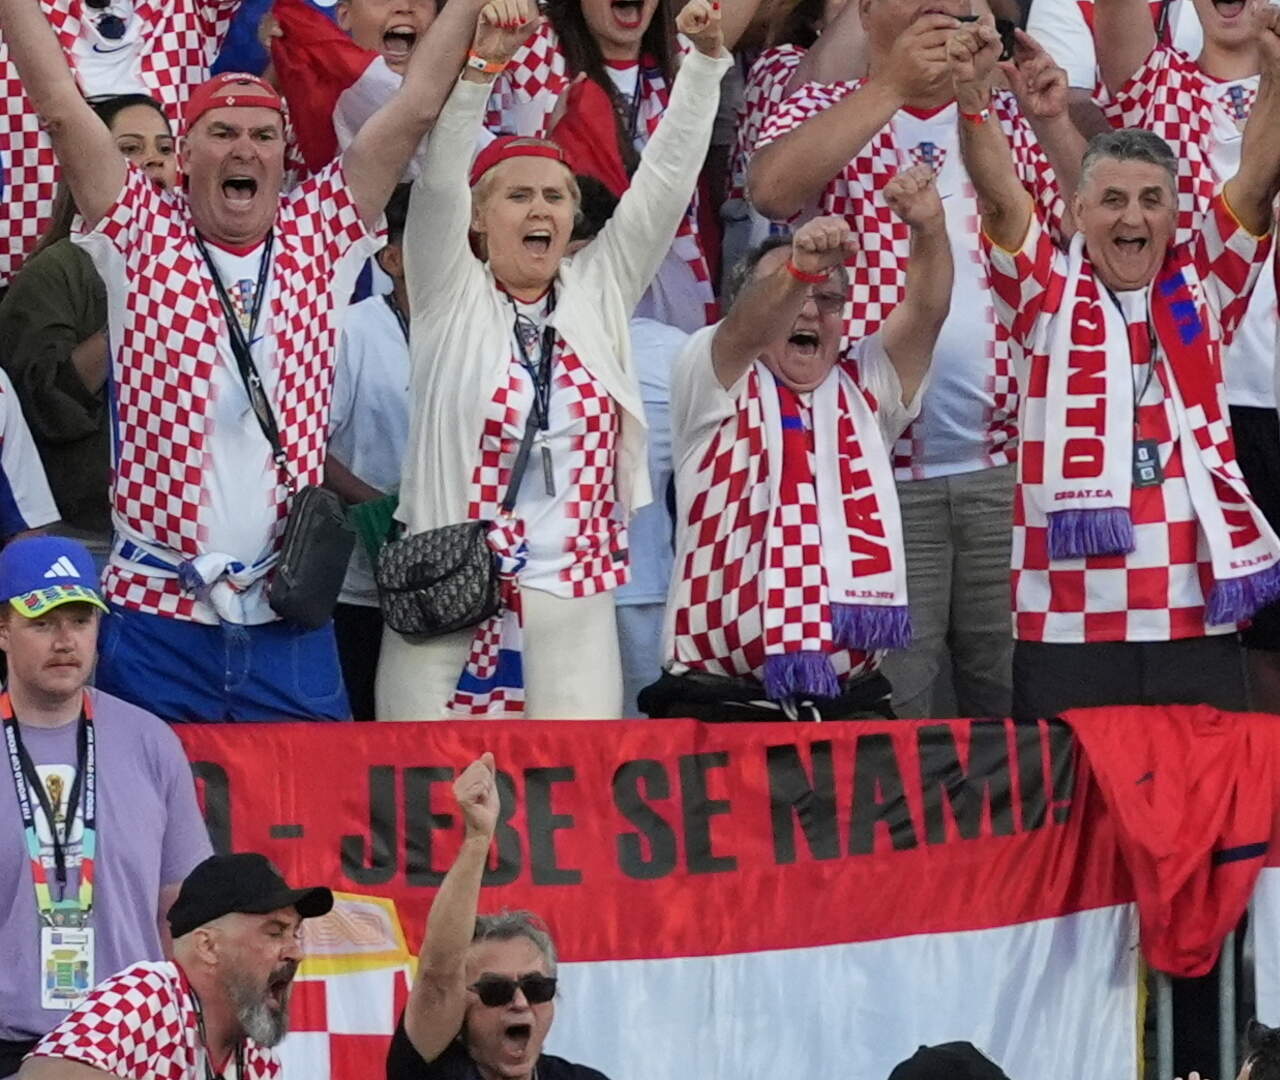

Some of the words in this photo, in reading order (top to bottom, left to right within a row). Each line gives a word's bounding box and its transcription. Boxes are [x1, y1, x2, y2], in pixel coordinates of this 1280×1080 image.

[10, 754, 22, 771] CUP
[14, 771, 27, 801] WORLD
[341, 764, 582, 888] JEBE
[612, 750, 738, 880] SE
[766, 716, 1078, 866] NAMI!
